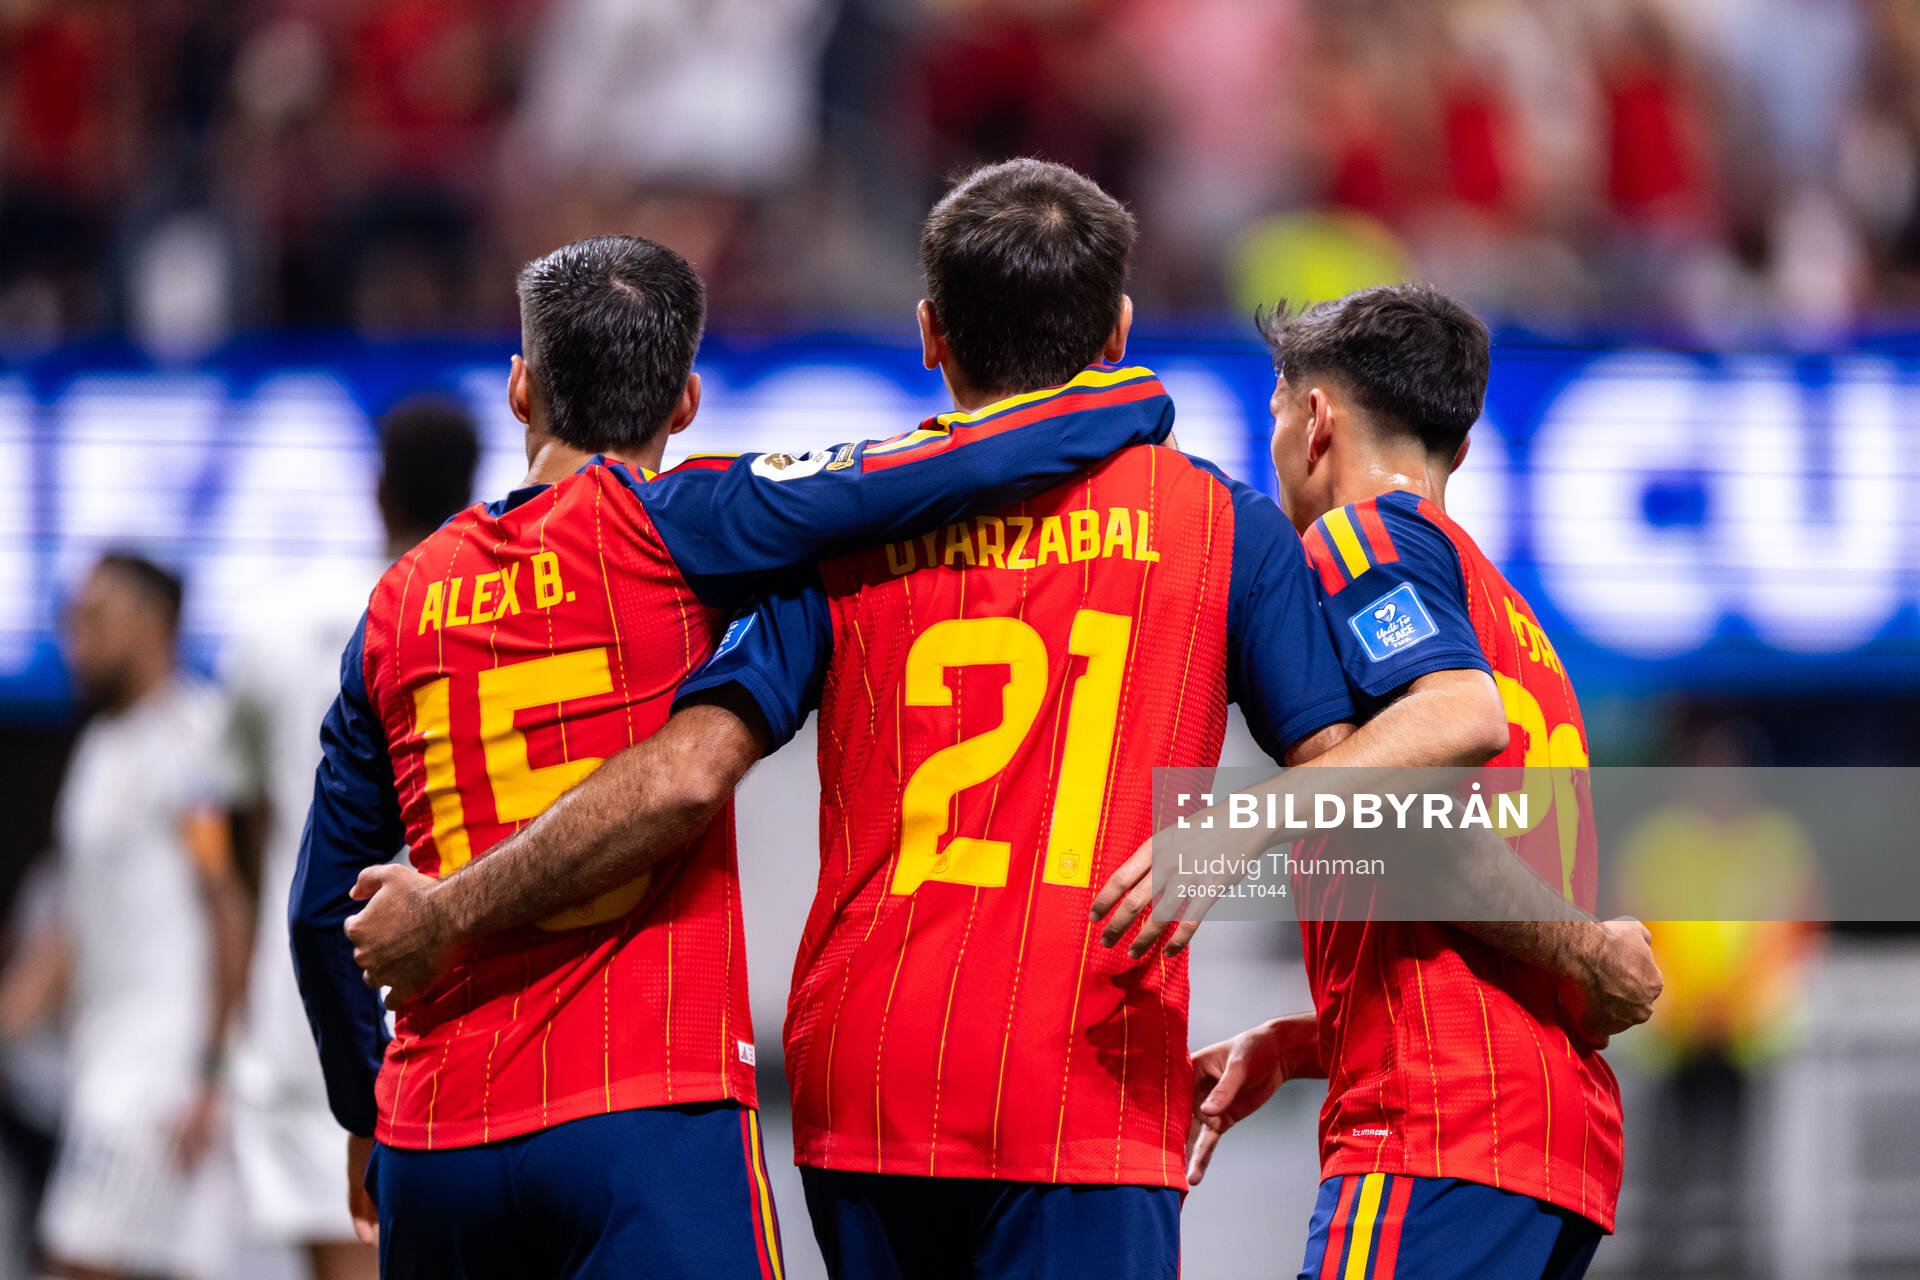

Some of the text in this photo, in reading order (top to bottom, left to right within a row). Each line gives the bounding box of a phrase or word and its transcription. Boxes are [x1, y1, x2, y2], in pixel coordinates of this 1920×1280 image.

[417, 551, 576, 636] ALEX B.
[1382, 623, 1416, 647] PEACE
[412, 646, 648, 930] 15
[890, 609, 1132, 896] 21
